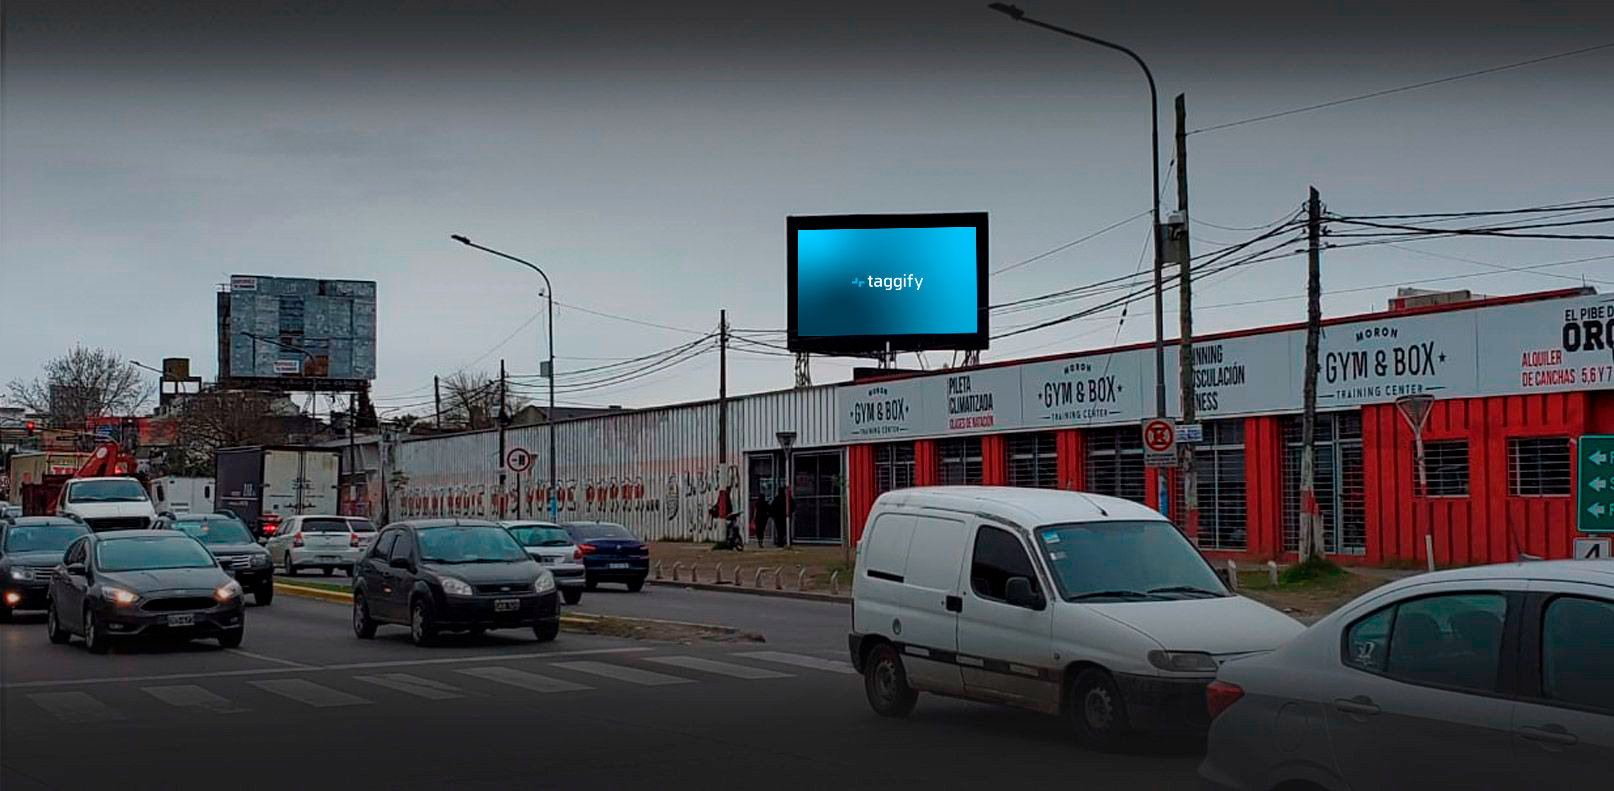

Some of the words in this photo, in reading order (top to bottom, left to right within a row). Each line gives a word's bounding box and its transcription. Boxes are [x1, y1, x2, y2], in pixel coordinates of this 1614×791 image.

[867, 273, 924, 291] taggify
[1565, 309, 1578, 322] EL
[1580, 305, 1605, 321] PIBE
[1355, 326, 1399, 341] MORON
[1326, 351, 1368, 384] GYM
[1374, 350, 1388, 377] &
[1393, 341, 1436, 376] BOX
[1522, 349, 1562, 367] ALQUILER
[1064, 363, 1092, 374] MORON
[1522, 371, 1533, 387] DE
[1535, 368, 1576, 387] CANCHAS
[949, 375, 971, 394] PILETA
[1044, 382, 1072, 408] GYM
[1076, 381, 1085, 403] &
[1088, 375, 1116, 403] BOX
[1336, 386, 1381, 399] TRAINING
[1385, 384, 1423, 396] CENTER
[854, 402, 875, 424] GYM
[877, 402, 884, 420] &
[885, 397, 905, 421] BOX
[949, 392, 993, 414] CLIMATIZADA
[1052, 411, 1081, 420] TRAINING
